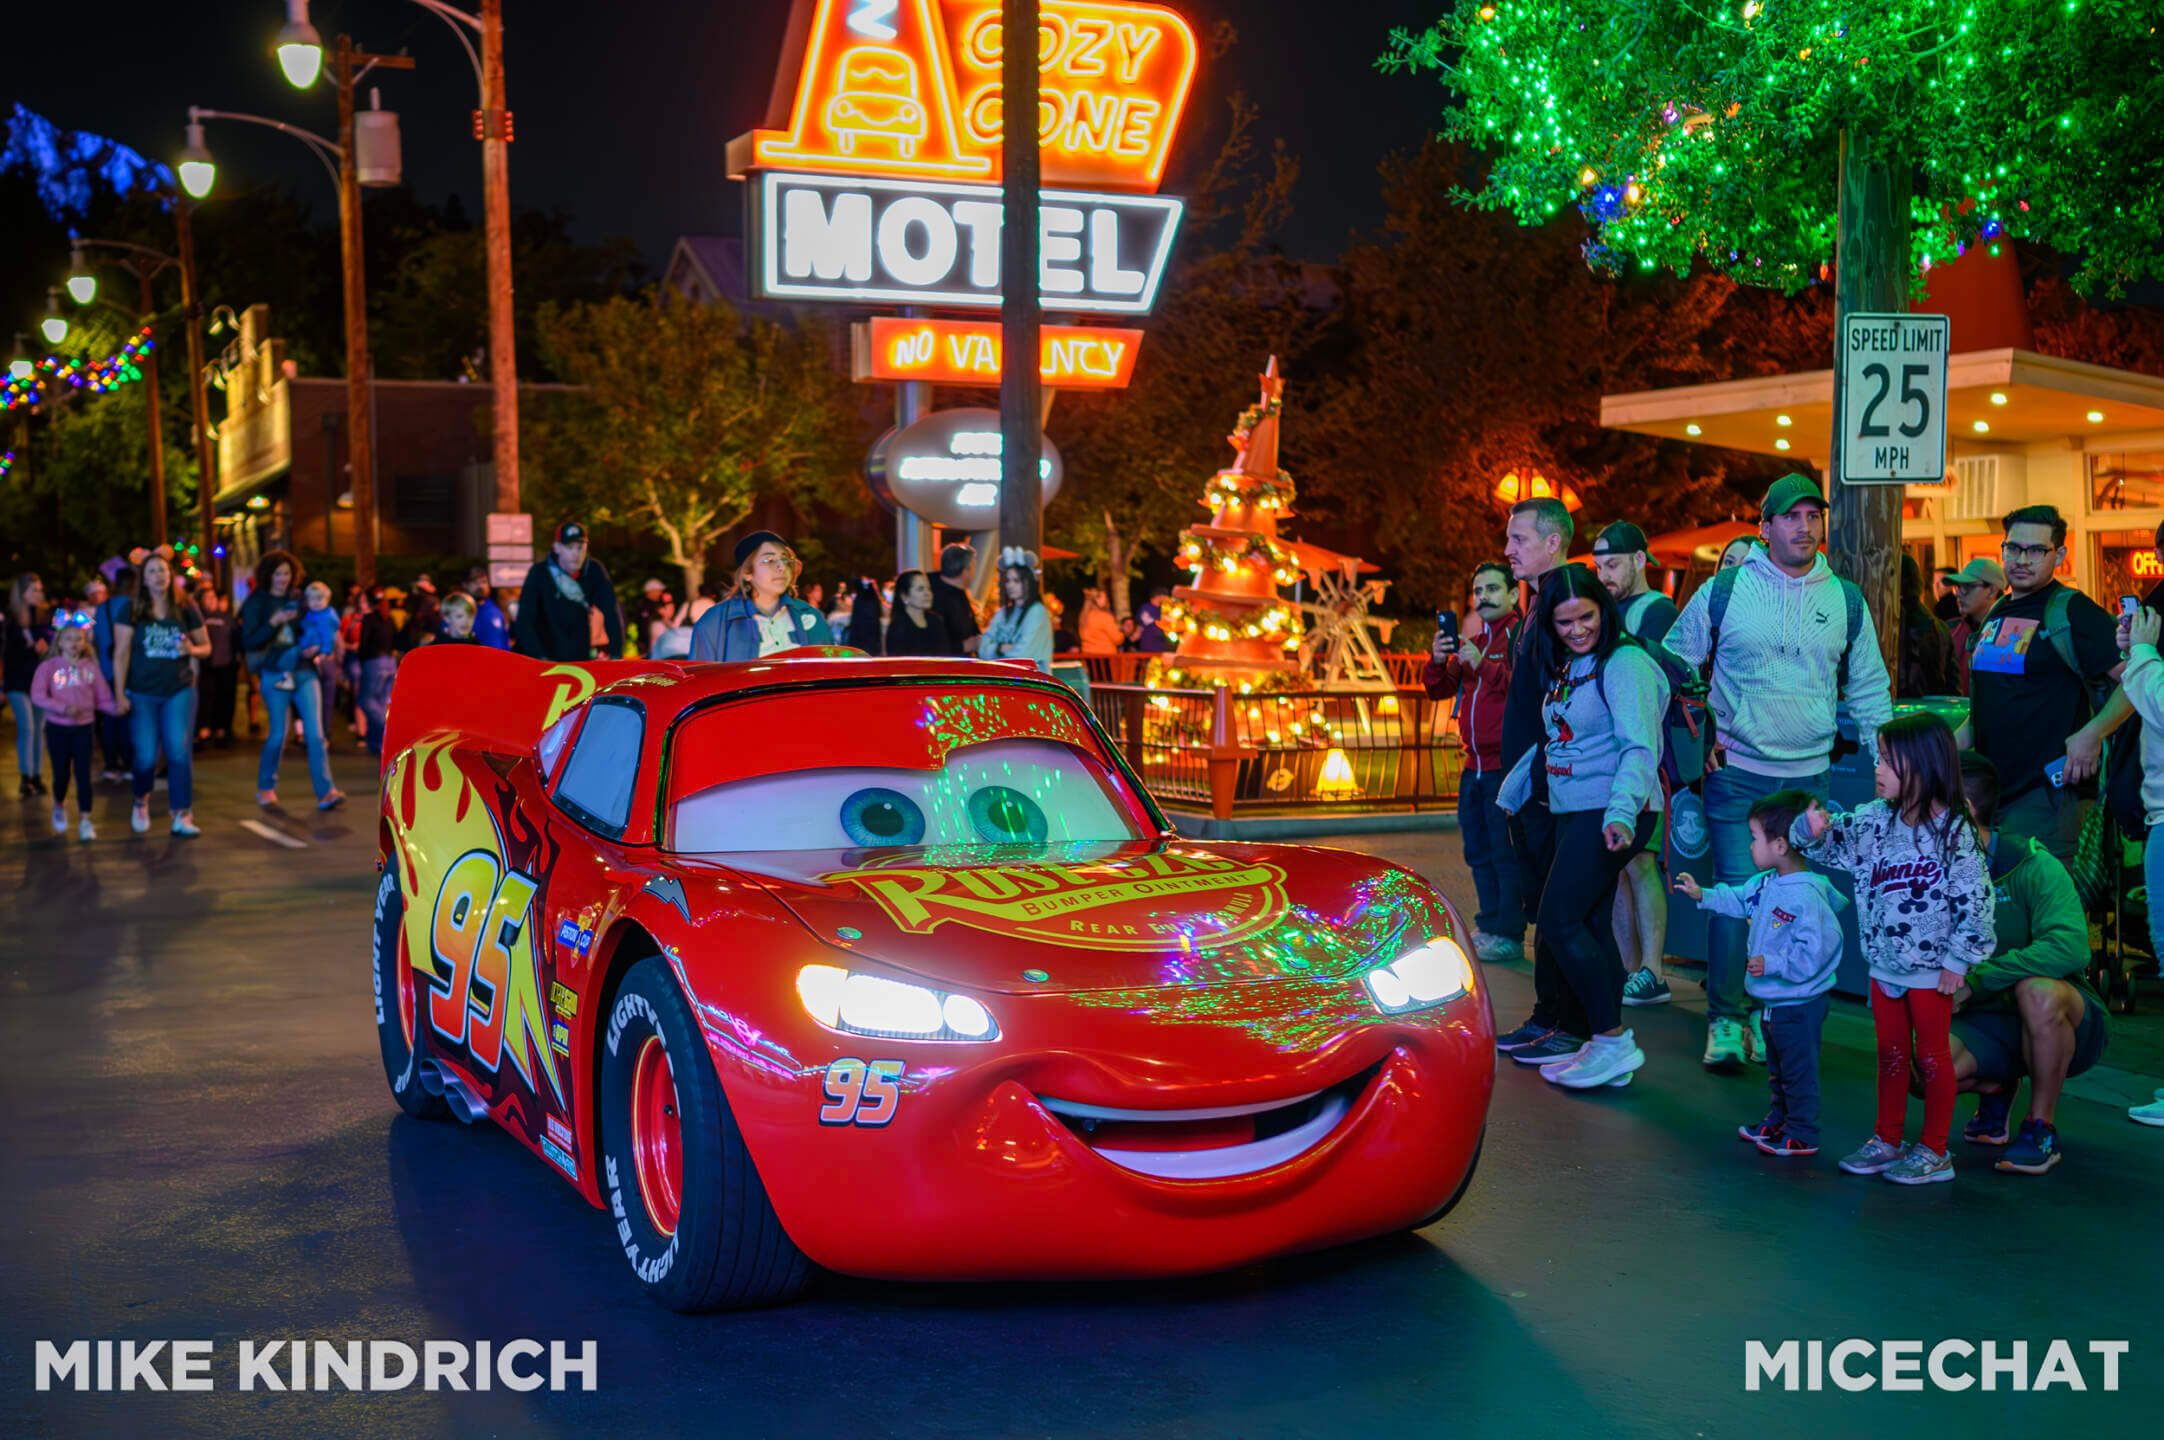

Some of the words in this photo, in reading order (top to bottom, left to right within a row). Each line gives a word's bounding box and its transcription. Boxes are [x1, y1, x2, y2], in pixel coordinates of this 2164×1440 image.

[965, 8, 1161, 81] COZY
[963, 82, 1160, 155] CONE
[785, 188, 1146, 295] MOTEL
[895, 329, 936, 368] NO
[948, 333, 1126, 377] VANCY
[1851, 328, 1898, 352] SPEED
[1903, 329, 1943, 353] LIMIT
[1860, 362, 1930, 439] 25
[1875, 446, 1909, 470] MPH
[1020, 888, 1125, 917] BUMPER
[1132, 873, 1251, 894] OINTMENT
[1069, 919, 1139, 936] REAR
[429, 848, 540, 1074] 95
[818, 1055, 906, 1129] 95
